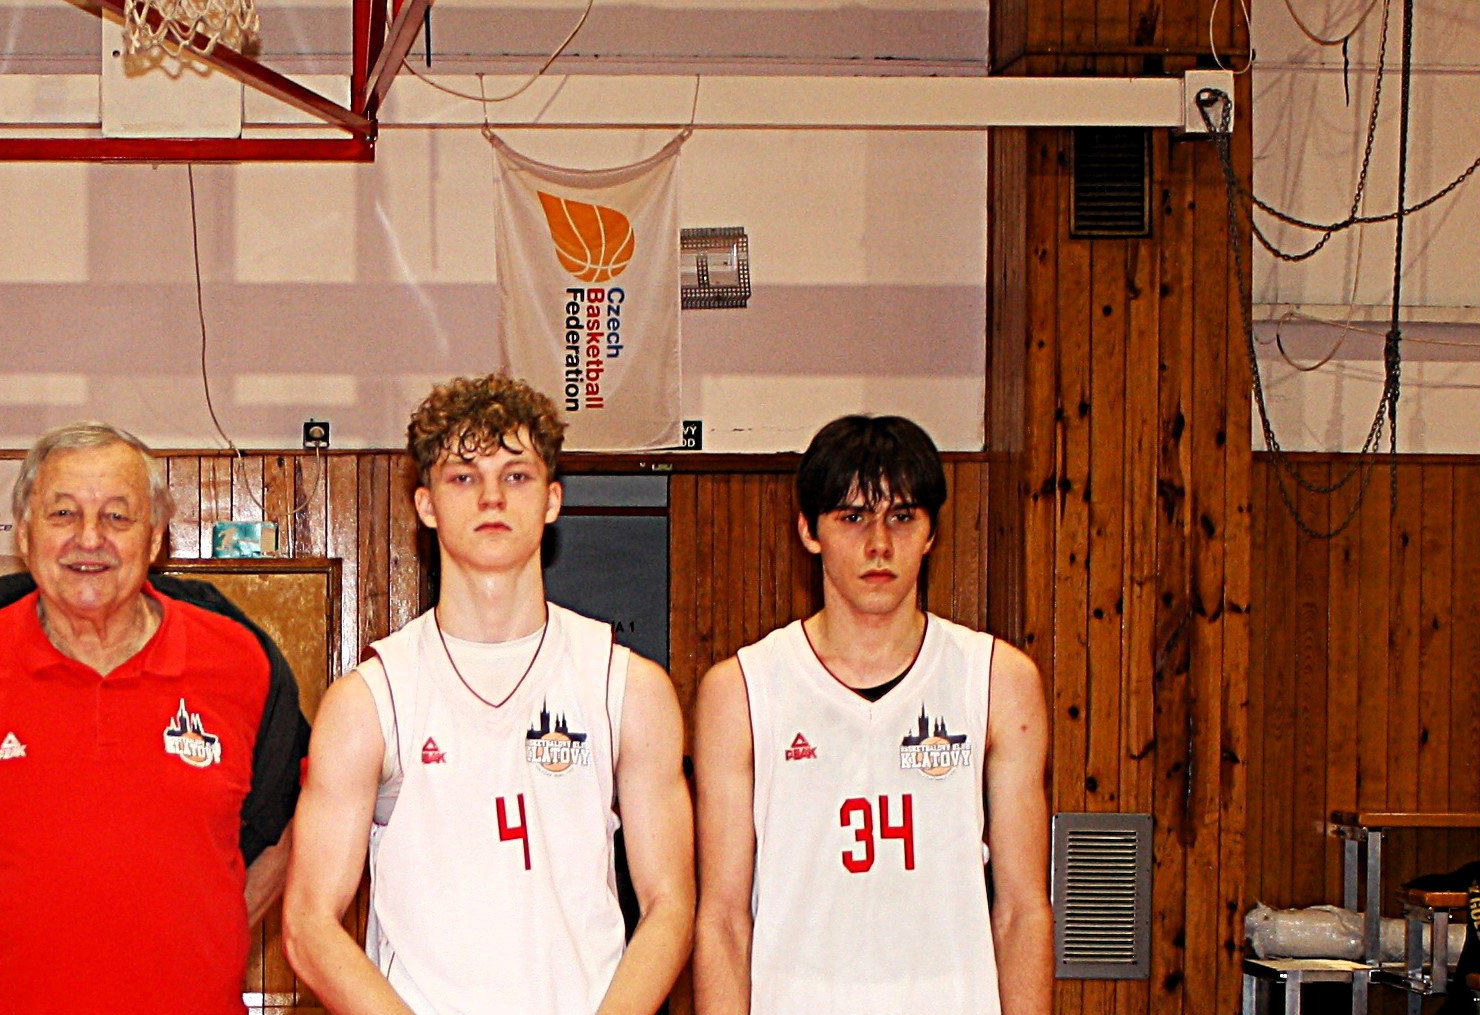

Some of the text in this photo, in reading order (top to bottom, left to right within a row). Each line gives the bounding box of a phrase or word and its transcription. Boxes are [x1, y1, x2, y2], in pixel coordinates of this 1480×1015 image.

[565, 287, 585, 412] Federation
[585, 287, 605, 409] Basketball
[607, 287, 625, 358] Czech
[900, 750, 971, 768] KLATOVY
[495, 793, 531, 871] 4
[839, 793, 915, 874] 34
